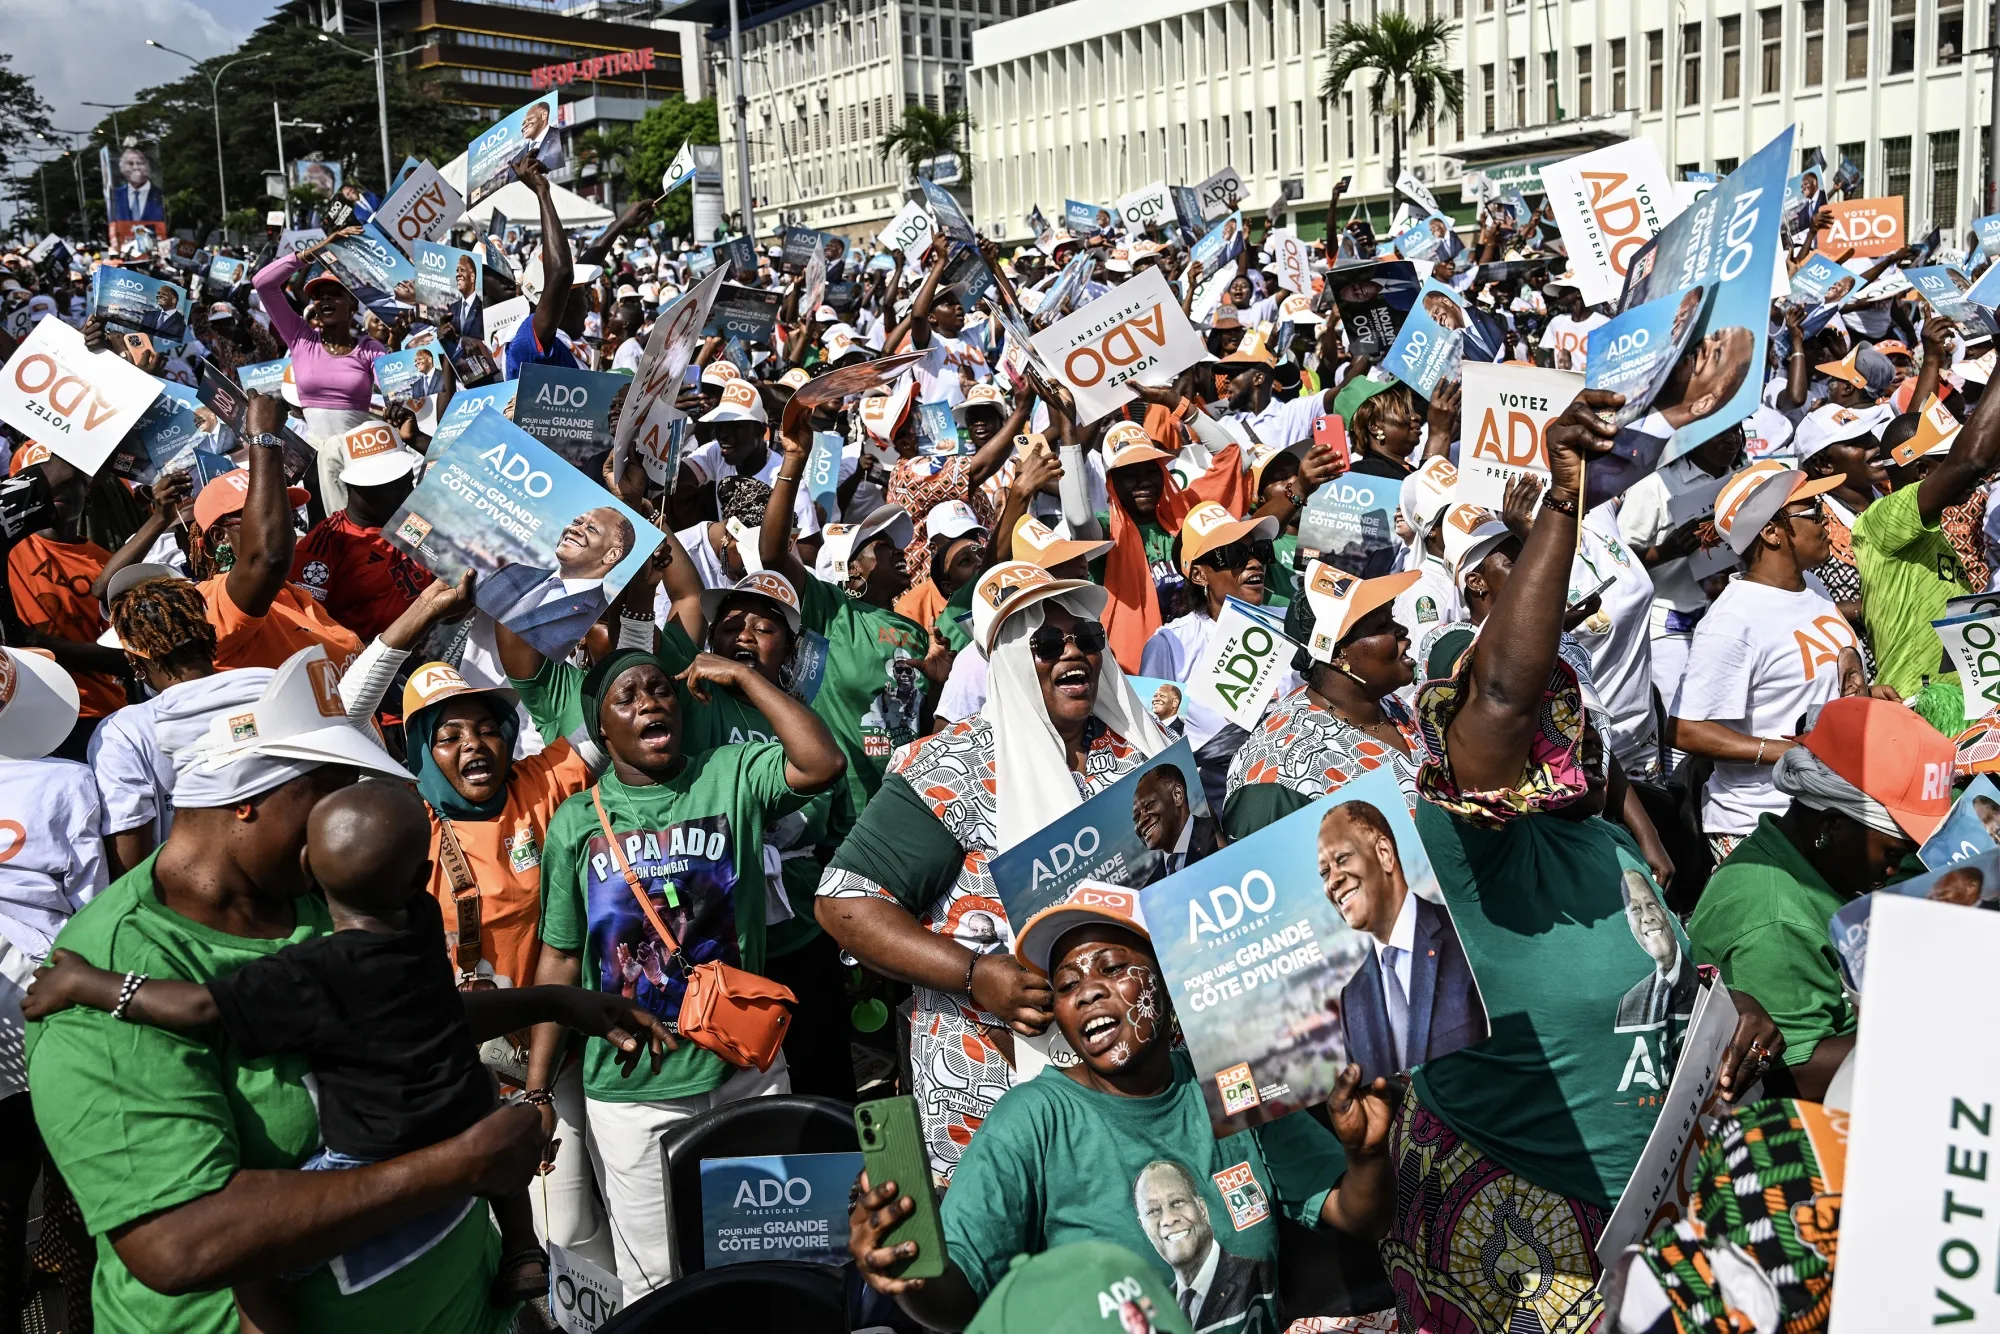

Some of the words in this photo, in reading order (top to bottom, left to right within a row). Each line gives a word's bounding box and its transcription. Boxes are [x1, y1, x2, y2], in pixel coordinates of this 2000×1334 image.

[531, 47, 656, 89] ISFOP-OPTIQUE
[477, 127, 507, 155] ADO
[1202, 178, 1239, 208] ADO
[1404, 180, 1439, 209] ADO
[398, 182, 447, 241] ADO
[1071, 206, 1088, 216] ADO
[1126, 194, 1163, 223] ADO
[1636, 184, 1662, 237] VOTEZ
[1844, 209, 1877, 218] VOTEZ
[895, 215, 927, 250] ADO
[1574, 191, 1607, 267] PRÉSIDENT
[1581, 172, 1649, 277] ADO
[1686, 207, 1707, 256] CÔTE
[1719, 188, 1763, 281] ADO
[1827, 215, 1897, 242] ADO
[741, 243, 749, 262] ADO
[793, 233, 816, 245] ADO
[1197, 236, 1215, 255] ADO
[1404, 231, 1423, 247] ADO
[1838, 239, 1886, 248] PRÉSIDENT
[215, 260, 230, 271] ADO
[364, 239, 396, 268] ADO
[422, 251, 446, 269] ADO
[692, 252, 707, 260] ADO
[1284, 239, 1301, 289] ADO
[117, 278, 144, 292] ADO
[968, 271, 988, 296] ADO
[1807, 263, 1832, 279] ADO
[1919, 276, 1944, 289] ADO
[727, 321, 760, 333] ADO
[1070, 302, 1141, 347] PRÉSIDENT
[1353, 316, 1375, 344] ADO
[1379, 307, 1396, 345] NATION
[1065, 302, 1166, 388] ADO
[1401, 331, 1427, 369] ADO
[1427, 337, 1445, 366] GRANDE
[1606, 328, 1649, 360] ADO
[251, 363, 283, 377] ADO
[384, 361, 404, 374] ADO
[1108, 355, 1159, 388] VOTEZ
[1621, 351, 1657, 370] GRANDE
[15, 353, 121, 432] ADO
[724, 384, 752, 402] ADO
[1423, 371, 1436, 390] CÔTE
[213, 388, 235, 417] ADO
[455, 395, 495, 416] ADO
[535, 383, 588, 408] ADO
[1499, 393, 1548, 411] VOTEZ
[25, 399, 71, 434] VOTEZ
[521, 417, 537, 425] POUR
[552, 416, 594, 429] GRANDE
[936, 411, 947, 429] ADO
[156, 425, 181, 443] ADO
[351, 429, 391, 453] ADO
[549, 428, 593, 440] D'IVOIRE
[1119, 429, 1150, 442] ADO
[479, 442, 553, 500] ADO
[815, 447, 832, 485] ADO
[448, 463, 469, 483] POUR
[469, 475, 487, 493] UNE
[487, 486, 543, 532] GRANDE
[483, 467, 529, 502] PRÉSIDENT
[1323, 483, 1375, 505] ADO
[438, 472, 474, 504] CÔTE
[475, 495, 532, 543] D'IVOIRE
[1310, 510, 1325, 519] POUR
[1325, 512, 1338, 520] UNE
[1338, 510, 1380, 526] GRANDE
[1330, 502, 1366, 511] PRÉSIDENT
[408, 516, 430, 532] RHDP
[1309, 515, 1335, 531] CÔTE
[1336, 520, 1378, 536] D'IVOIRE
[749, 573, 793, 604] ADO
[1000, 564, 1052, 588] ADO
[1212, 637, 1238, 675] VOTEZ
[1794, 606, 1859, 681] AD
[426, 669, 463, 688] AD
[809, 651, 819, 680] ADO
[1215, 626, 1274, 712] ADO
[1246, 651, 1279, 705] PRÉSIDENT
[1962, 647, 1978, 686] VOTEZ
[229, 714, 254, 728] RHDP
[865, 746, 889, 755] UNE
[1087, 753, 1115, 774] ADO
[669, 827, 726, 861] ADO
[1032, 825, 1100, 891] ADO
[651, 859, 689, 876] COMBAT
[1045, 858, 1095, 891] PRÉSIDENT
[1067, 852, 1124, 898] GRANDE
[1188, 870, 1276, 944] ADO
[1207, 916, 1271, 949] PRÉSIDENT
[1184, 971, 1214, 990] POUR
[1215, 961, 1238, 978] UNE
[1235, 920, 1314, 968] GRANDE
[1189, 980, 1243, 1012] CÔTE
[1244, 941, 1323, 993] D'IVOIRE
[1218, 1067, 1247, 1087] RHDP
[950, 1102, 987, 1117] STABILIT
[1644, 1066, 1711, 1222] PRÉSIDENT
[733, 1178, 811, 1208] ADO
[1218, 1167, 1250, 1193] RHDP
[746, 1208, 800, 1216] PRÉSIDENT
[1932, 1097, 1992, 1327] VOTEZ
[718, 1227, 742, 1236] POUR
[743, 1226, 762, 1235] UNE
[763, 1220, 828, 1234] GRANDE
[718, 1237, 760, 1252] CÔTE
[763, 1234, 829, 1249] D'IVOIRE
[566, 1267, 607, 1293] PRÉSIDENT
[556, 1274, 616, 1324] ADO
[1098, 1276, 1140, 1319] ADO
[572, 1316, 596, 1333] OTEZ
